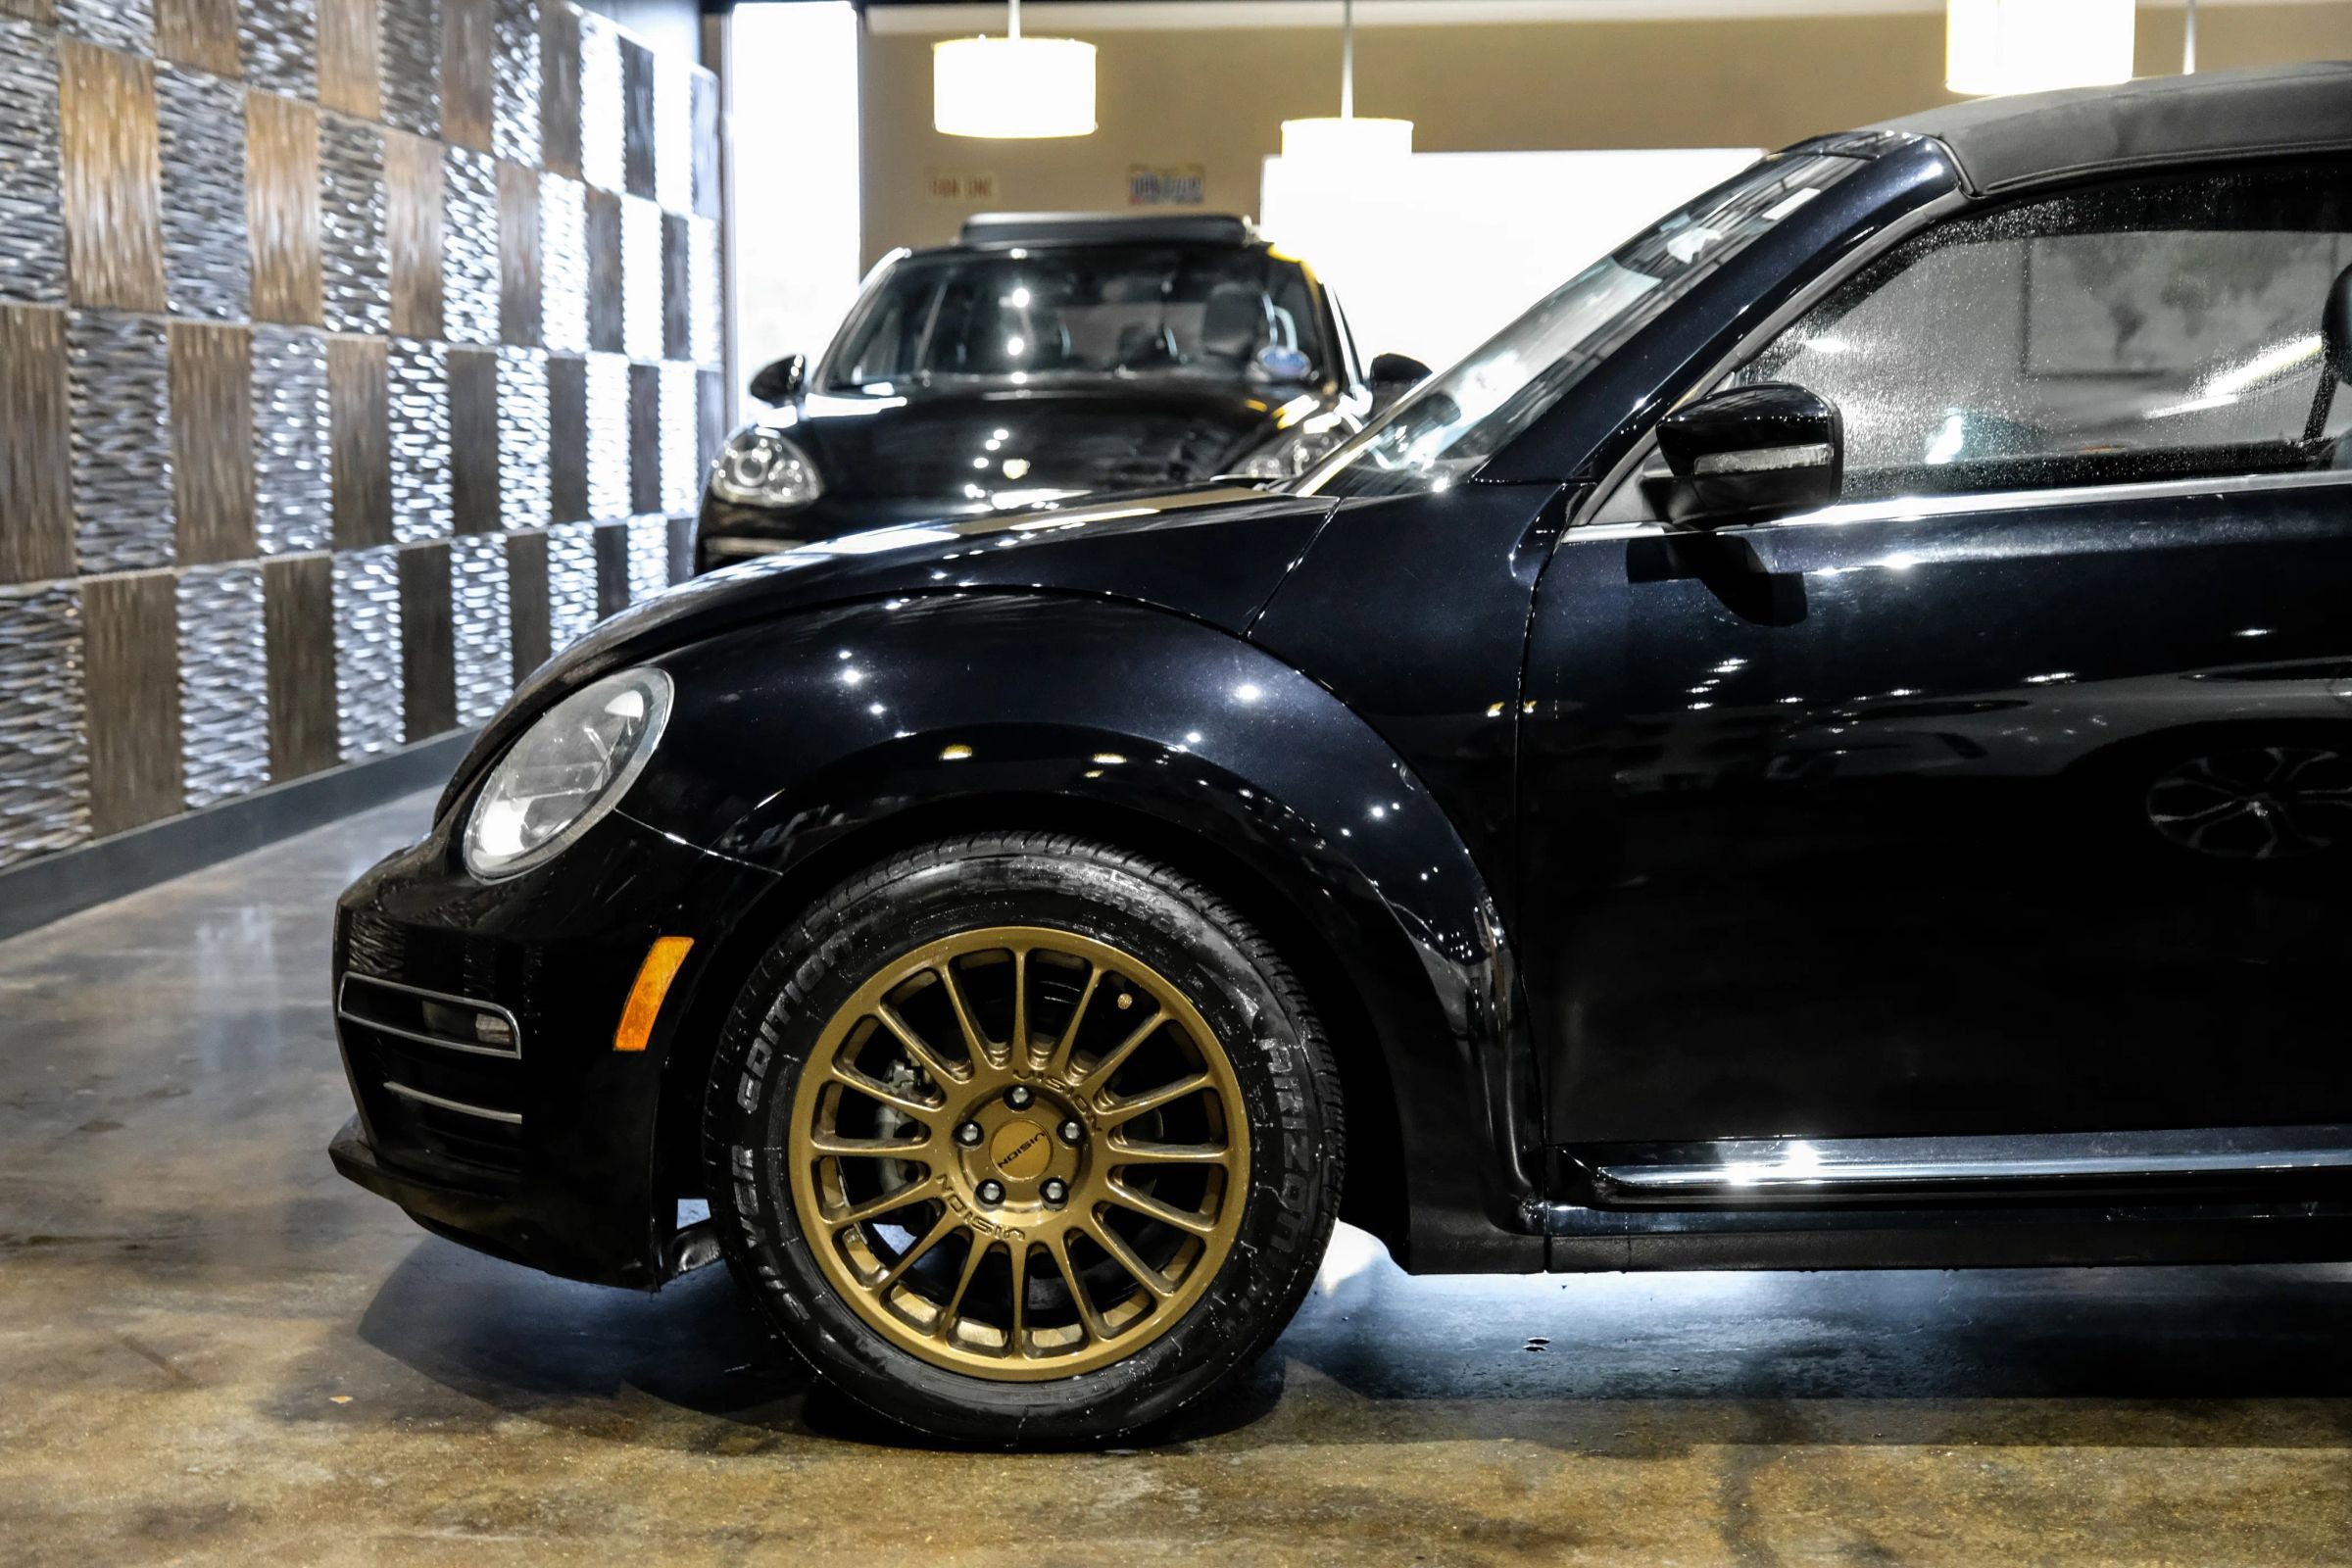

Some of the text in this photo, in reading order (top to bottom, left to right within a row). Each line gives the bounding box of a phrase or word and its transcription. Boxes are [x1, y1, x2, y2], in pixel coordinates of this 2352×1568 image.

[1012, 1068, 1103, 1133] VISION
[998, 1131, 1047, 1169] VISION
[936, 1173, 1026, 1241] VISION
